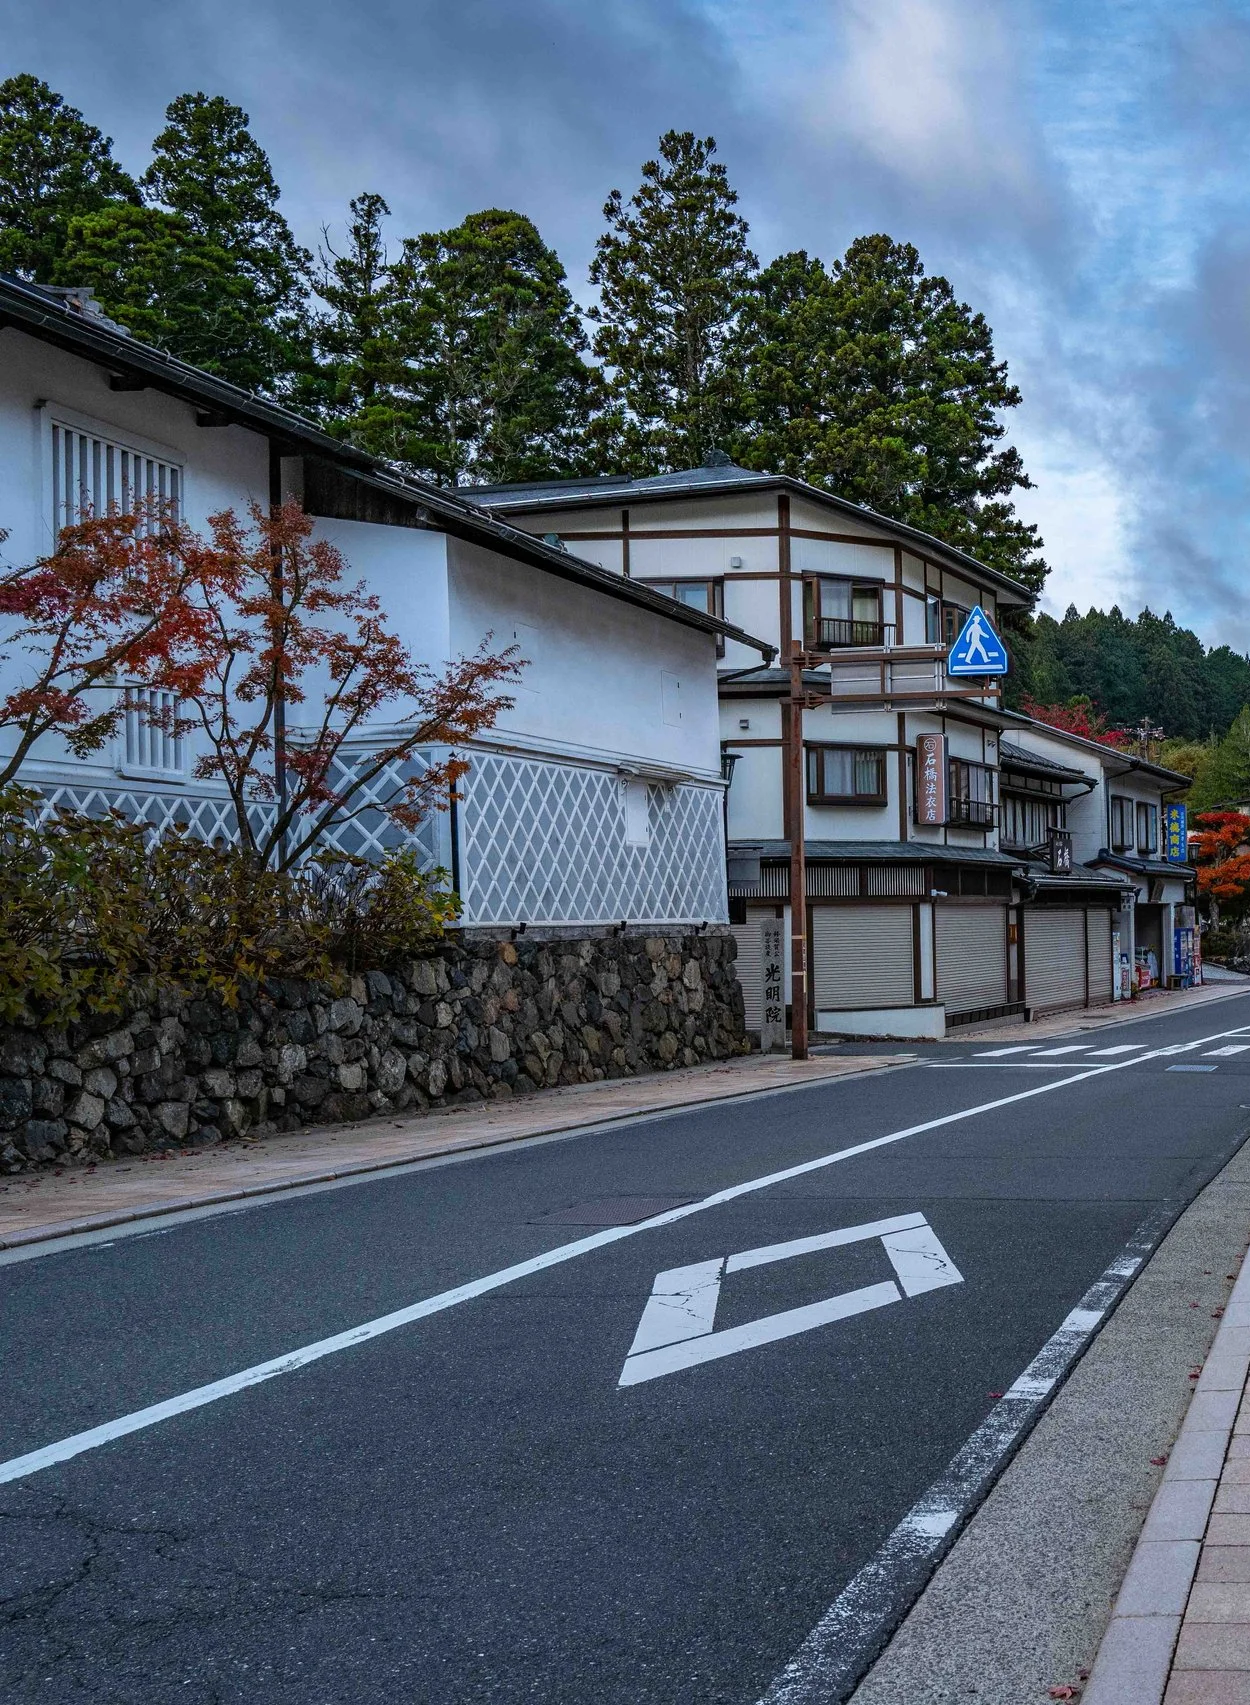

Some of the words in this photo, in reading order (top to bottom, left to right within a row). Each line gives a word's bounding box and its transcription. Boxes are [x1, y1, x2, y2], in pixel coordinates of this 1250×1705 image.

[924, 752, 937, 821] 石橋法衣店
[765, 963, 781, 1023] 光明院
